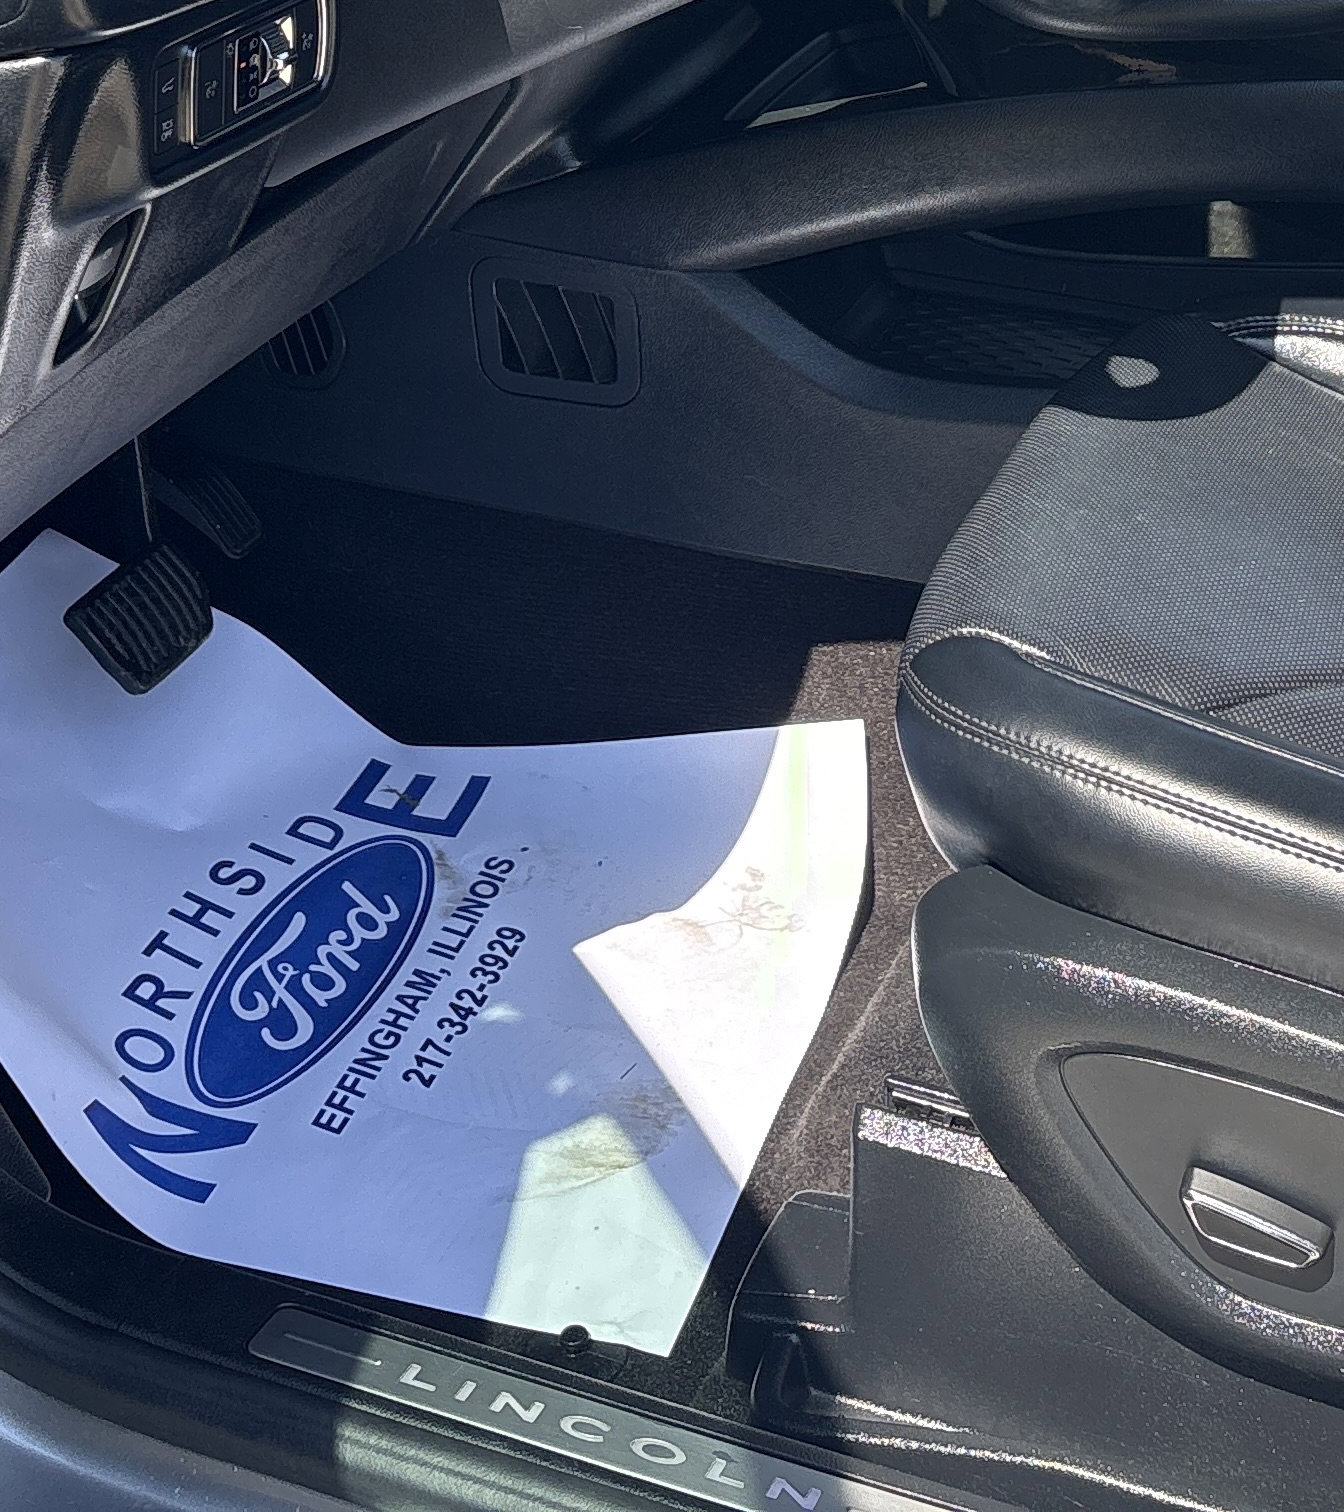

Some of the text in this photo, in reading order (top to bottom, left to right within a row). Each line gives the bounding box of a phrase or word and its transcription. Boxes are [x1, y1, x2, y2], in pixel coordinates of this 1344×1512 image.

[83, 758, 492, 1204] NORTHSIDE
[229, 879, 401, 1051] Ford
[311, 965, 452, 1135] EFFINGHAM,
[401, 925, 528, 1089] 217-342-3929
[398, 1362, 823, 1512] LINCOLN
